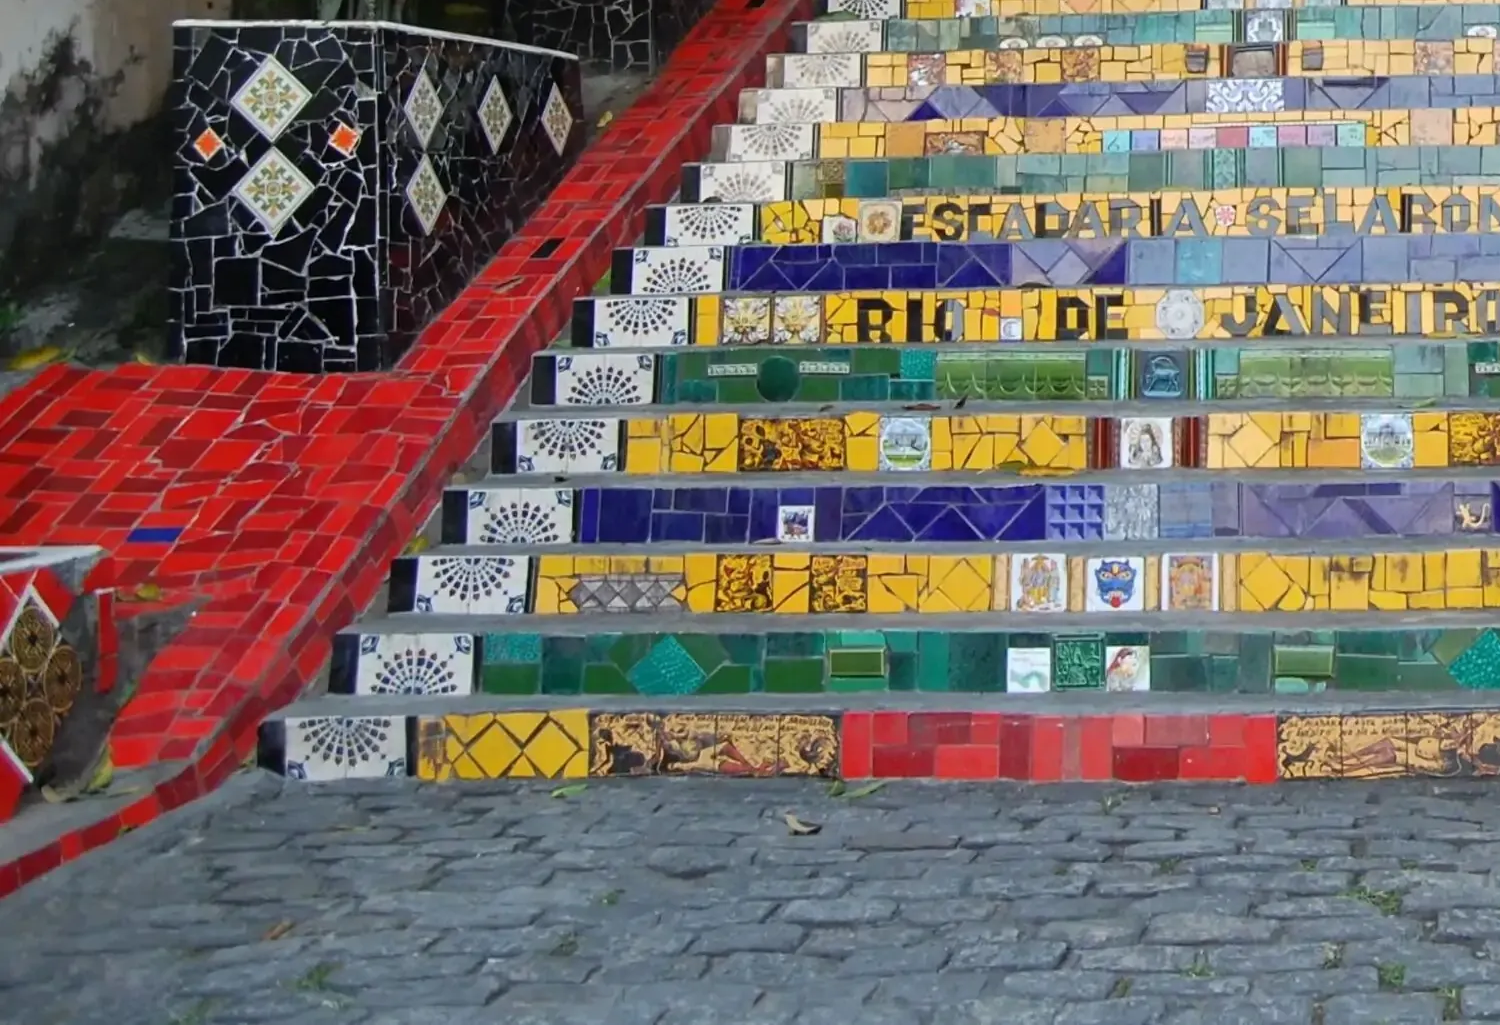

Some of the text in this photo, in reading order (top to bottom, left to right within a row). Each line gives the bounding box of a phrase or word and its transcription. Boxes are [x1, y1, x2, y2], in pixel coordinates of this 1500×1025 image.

[902, 198, 1211, 241] ESCADARIA
[857, 297, 964, 342] RIO
[1056, 294, 1128, 341] DE
